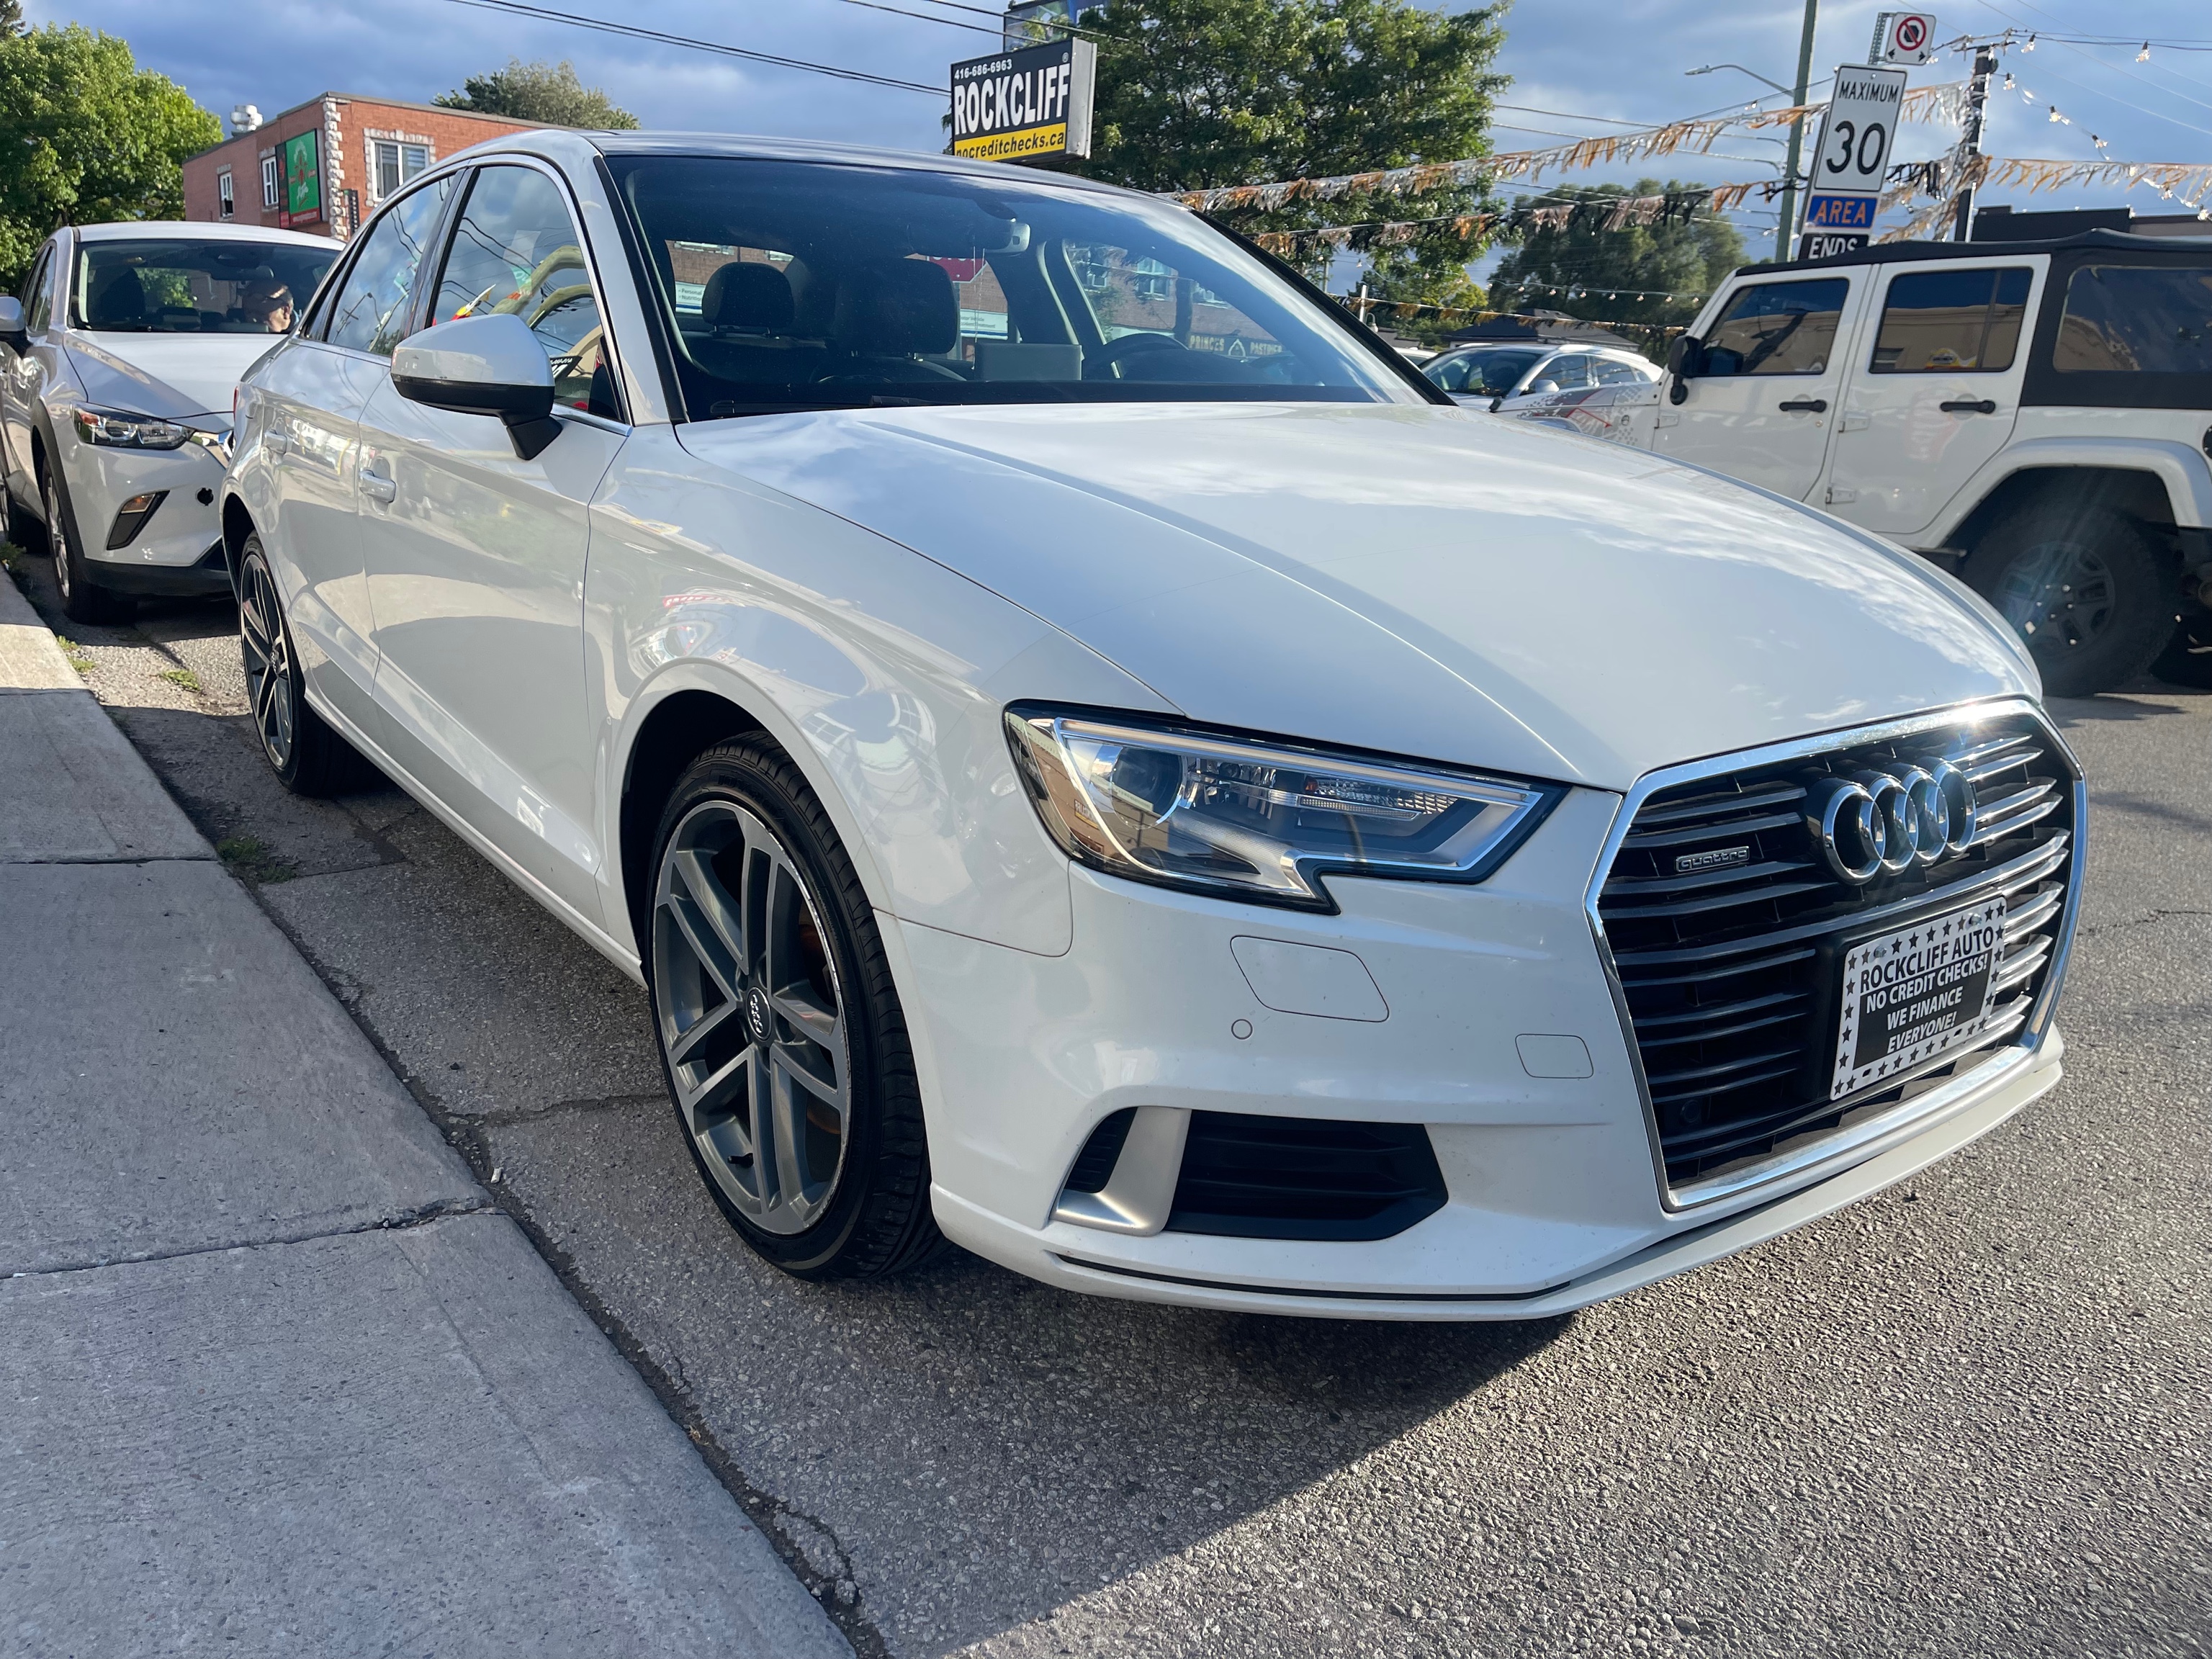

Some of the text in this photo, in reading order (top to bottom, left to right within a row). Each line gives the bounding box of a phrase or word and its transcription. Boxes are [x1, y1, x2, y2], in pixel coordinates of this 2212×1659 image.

[954, 59, 1012, 80] 416-686-6963
[954, 63, 1071, 135] ROCKCLIFF
[1838, 81, 1899, 103] MAXIMUM
[956, 132, 1064, 157] nocreditchecks.ca
[1826, 120, 1886, 175] 30
[1815, 199, 1866, 225] AREA
[1808, 236, 1858, 260] ENDS
[1681, 850, 1748, 869] quattro
[1860, 926, 1994, 993] ROCKCLIFF AUTO
[1866, 953, 1987, 1014] NO CREDIT CHECKS!
[1887, 986, 1964, 1031] WE FINANCE
[1887, 1011, 1958, 1054] EVERYONE!
